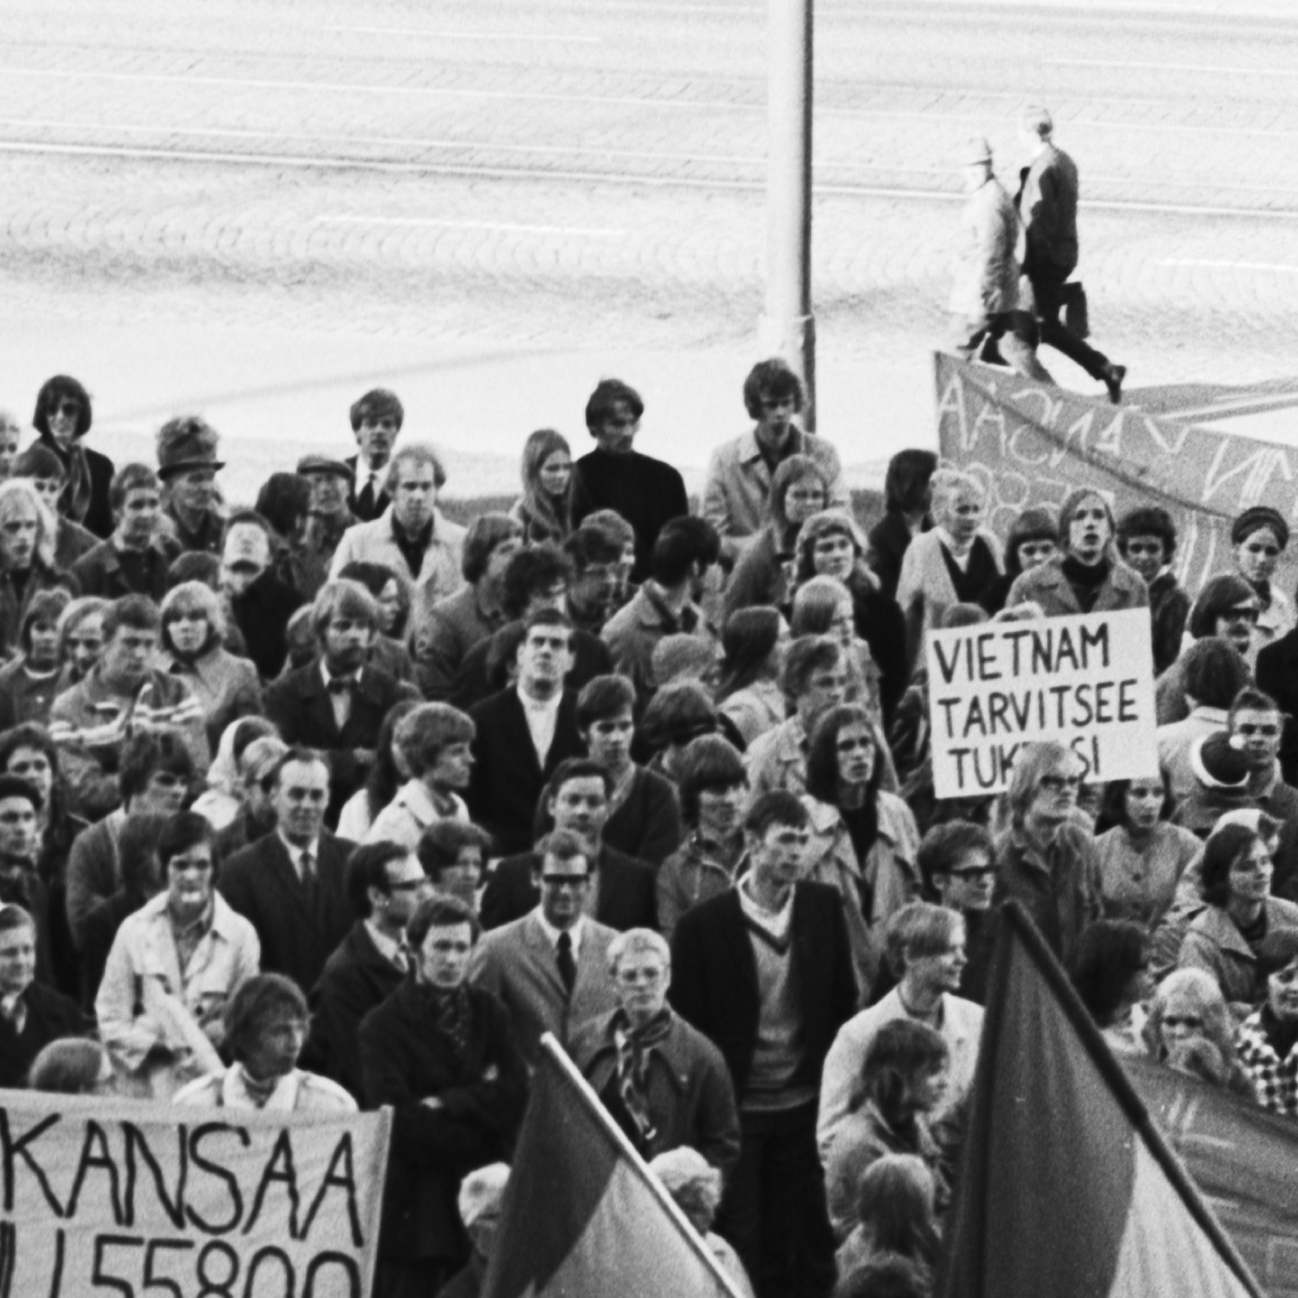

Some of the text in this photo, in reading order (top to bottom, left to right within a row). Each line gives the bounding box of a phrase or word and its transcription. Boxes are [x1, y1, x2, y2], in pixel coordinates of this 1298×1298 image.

[933, 622, 1110, 683] VIETNAM
[937, 679, 1139, 739] TARVITSEE
[947, 736, 1100, 791] TUKSI
